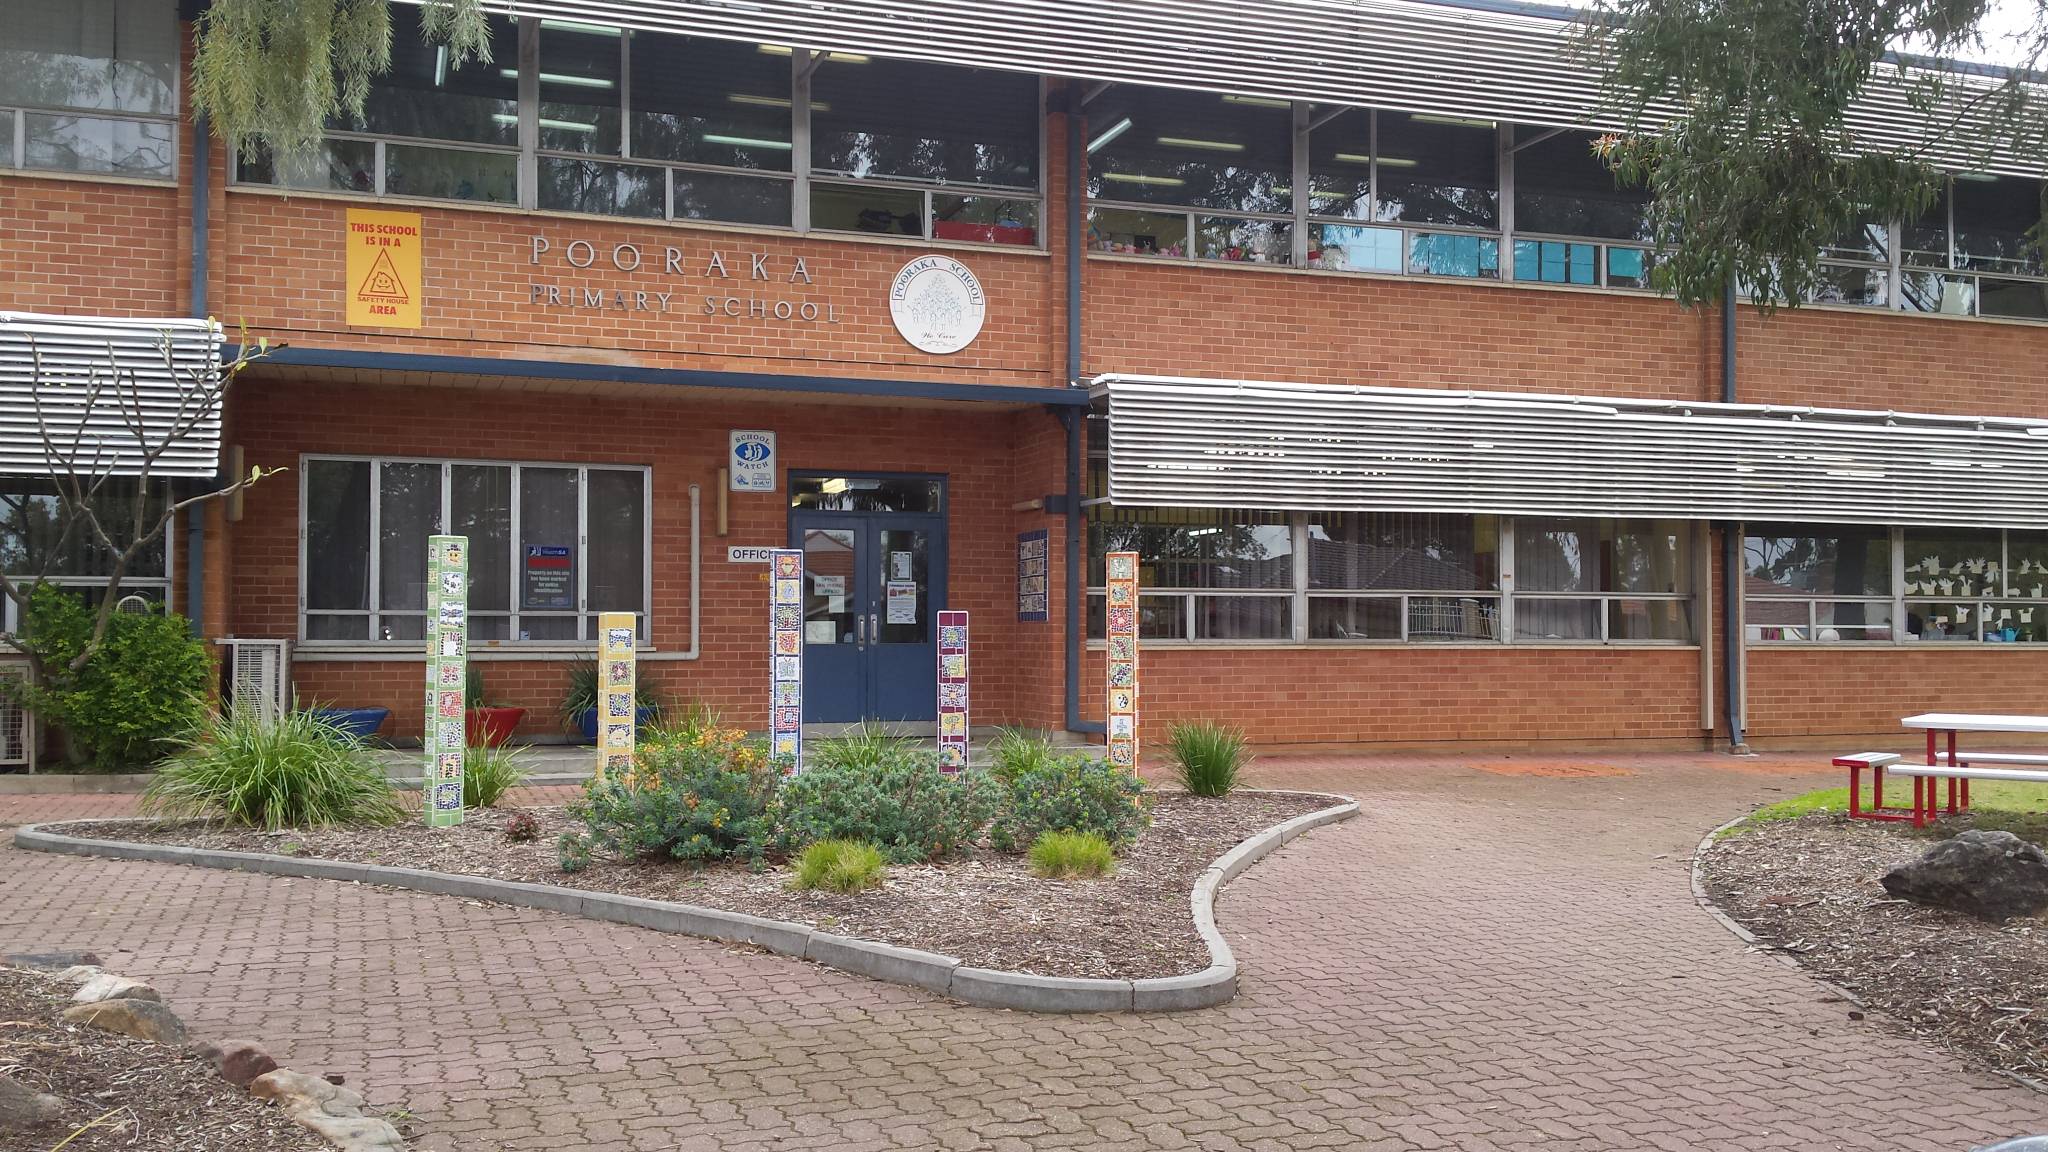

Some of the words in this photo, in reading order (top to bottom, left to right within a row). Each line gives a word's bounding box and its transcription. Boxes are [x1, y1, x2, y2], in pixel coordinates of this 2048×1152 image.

[350, 223, 374, 233] THIS
[376, 225, 418, 236] SCHOOL
[365, 236, 375, 245] IS
[378, 237, 390, 246] IN
[394, 238, 401, 247] A
[530, 235, 813, 284] POORAKA
[895, 258, 937, 298] POORAKA
[949, 263, 980, 303] SCHOOL
[386, 297, 409, 305] HOUSE
[530, 283, 673, 312] PRIMARY
[704, 296, 840, 323] SCHOOL
[369, 305, 397, 315] AREA
[735, 434, 770, 445] SCHOOL
[737, 460, 769, 469] WATCH
[732, 549, 770, 560] OFFIC
